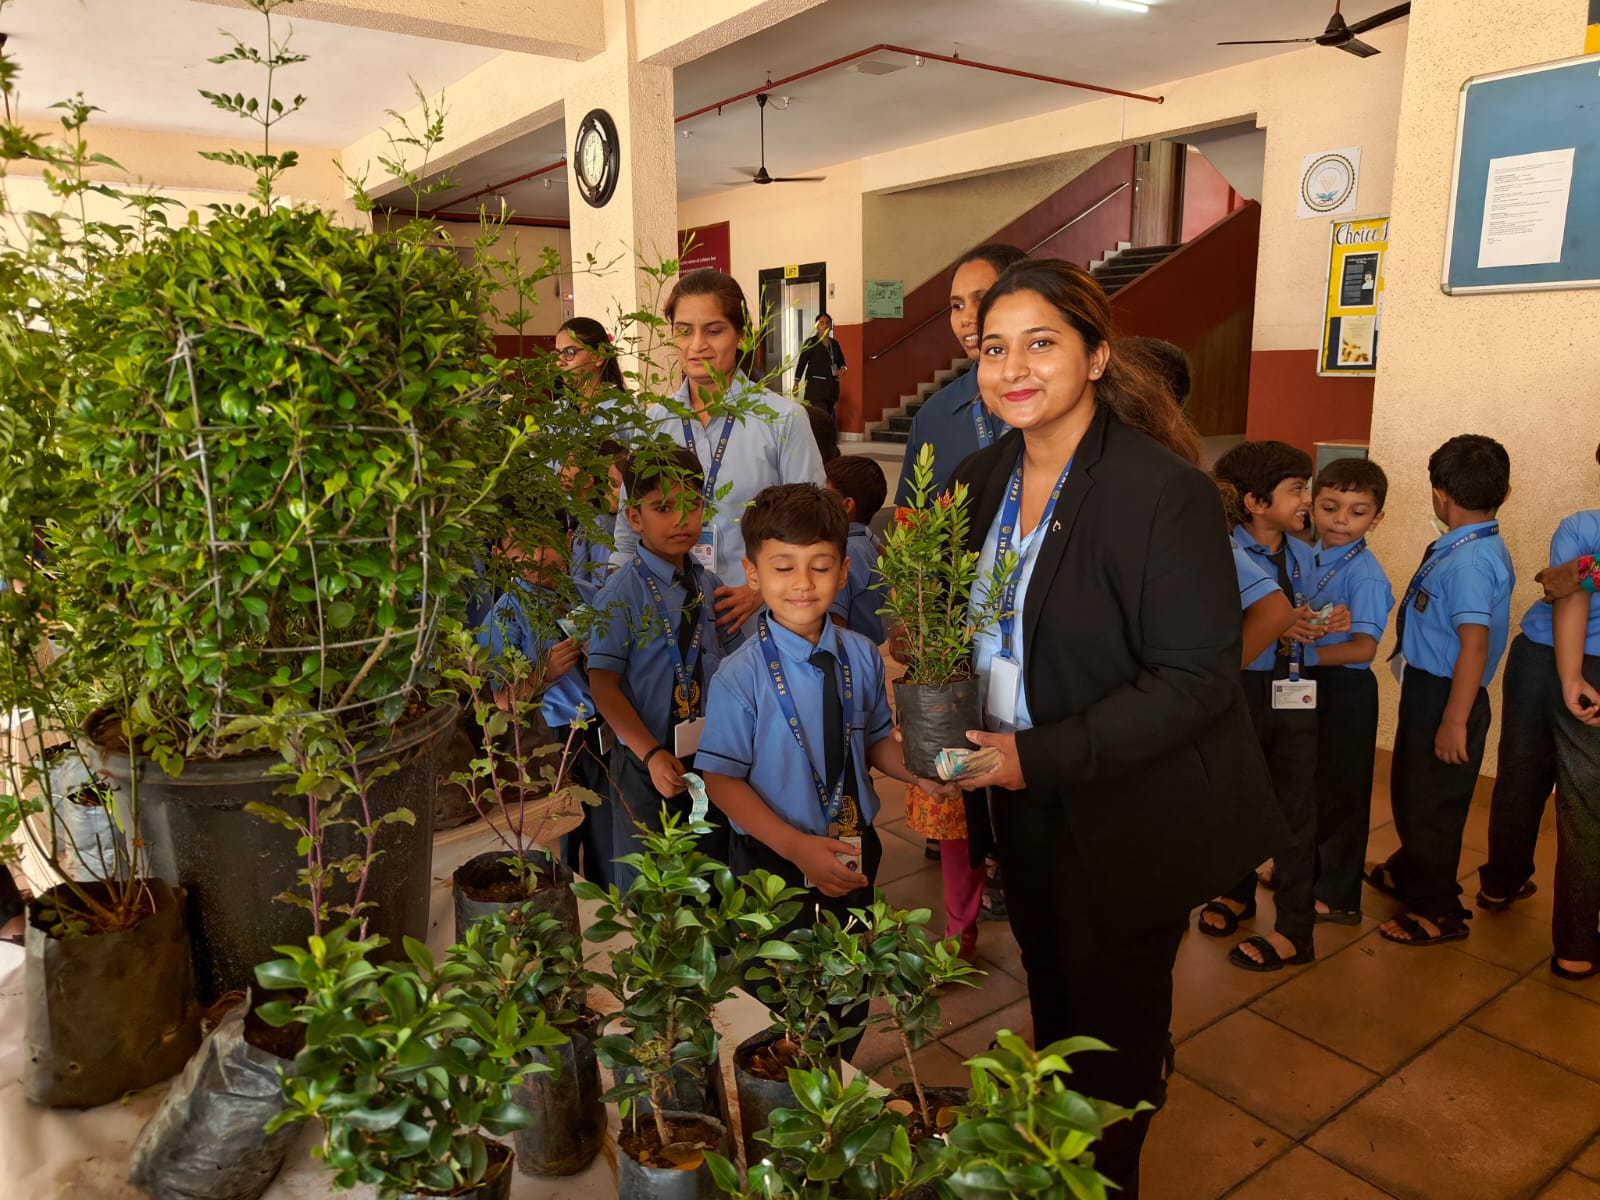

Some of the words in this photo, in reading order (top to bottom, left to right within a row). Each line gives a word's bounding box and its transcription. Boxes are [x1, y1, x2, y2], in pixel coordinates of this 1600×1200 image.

[1336, 223, 1377, 245] Choice
[785, 267, 797, 276] LIFT
[773, 671, 786, 696] INGS
